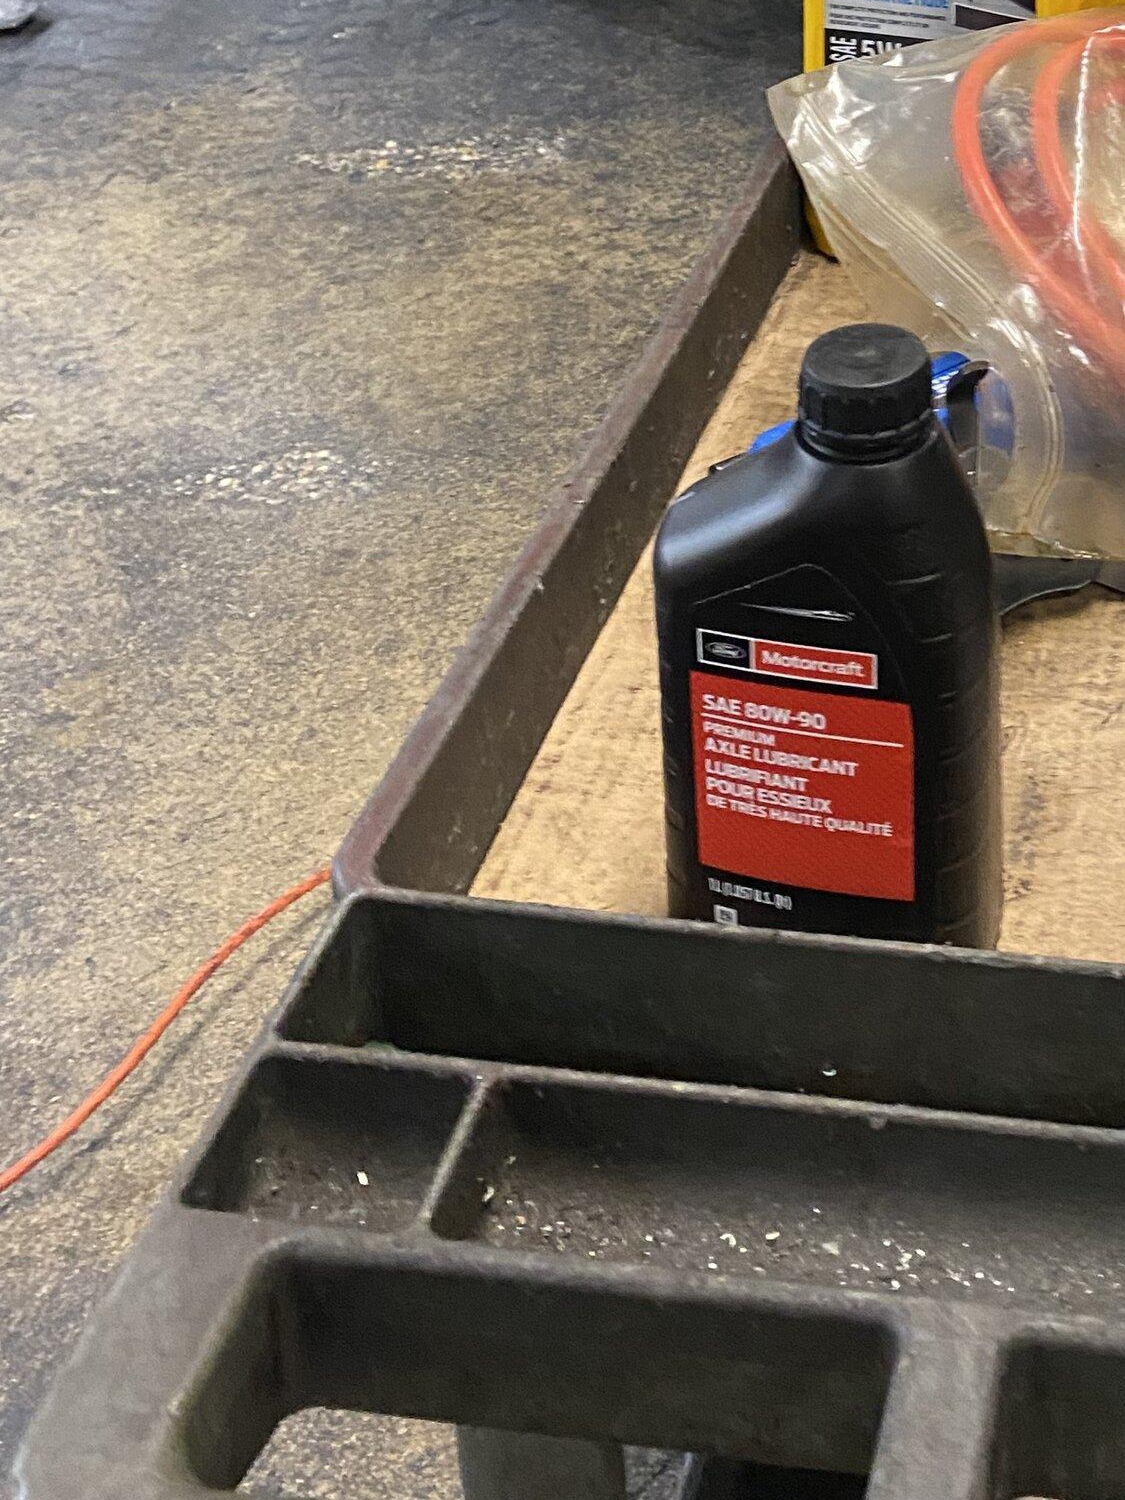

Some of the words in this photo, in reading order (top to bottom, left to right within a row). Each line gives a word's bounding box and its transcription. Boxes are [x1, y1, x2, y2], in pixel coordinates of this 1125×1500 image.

[761, 650, 865, 677] Motorcraft
[702, 694, 741, 715] SAE
[744, 703, 827, 730] 80W-90
[703, 721, 776, 746] PREMIUM
[704, 737, 752, 760] AXLE
[754, 747, 859, 776] LUBRICANT
[704, 759, 809, 791] LUBRIFIANT
[705, 777, 755, 800] POUR
[757, 787, 833, 814] ESSIEUX
[706, 794, 728, 808] DE
[769, 806, 823, 828] HAUTE
[824, 817, 894, 837] QUALITÉ
